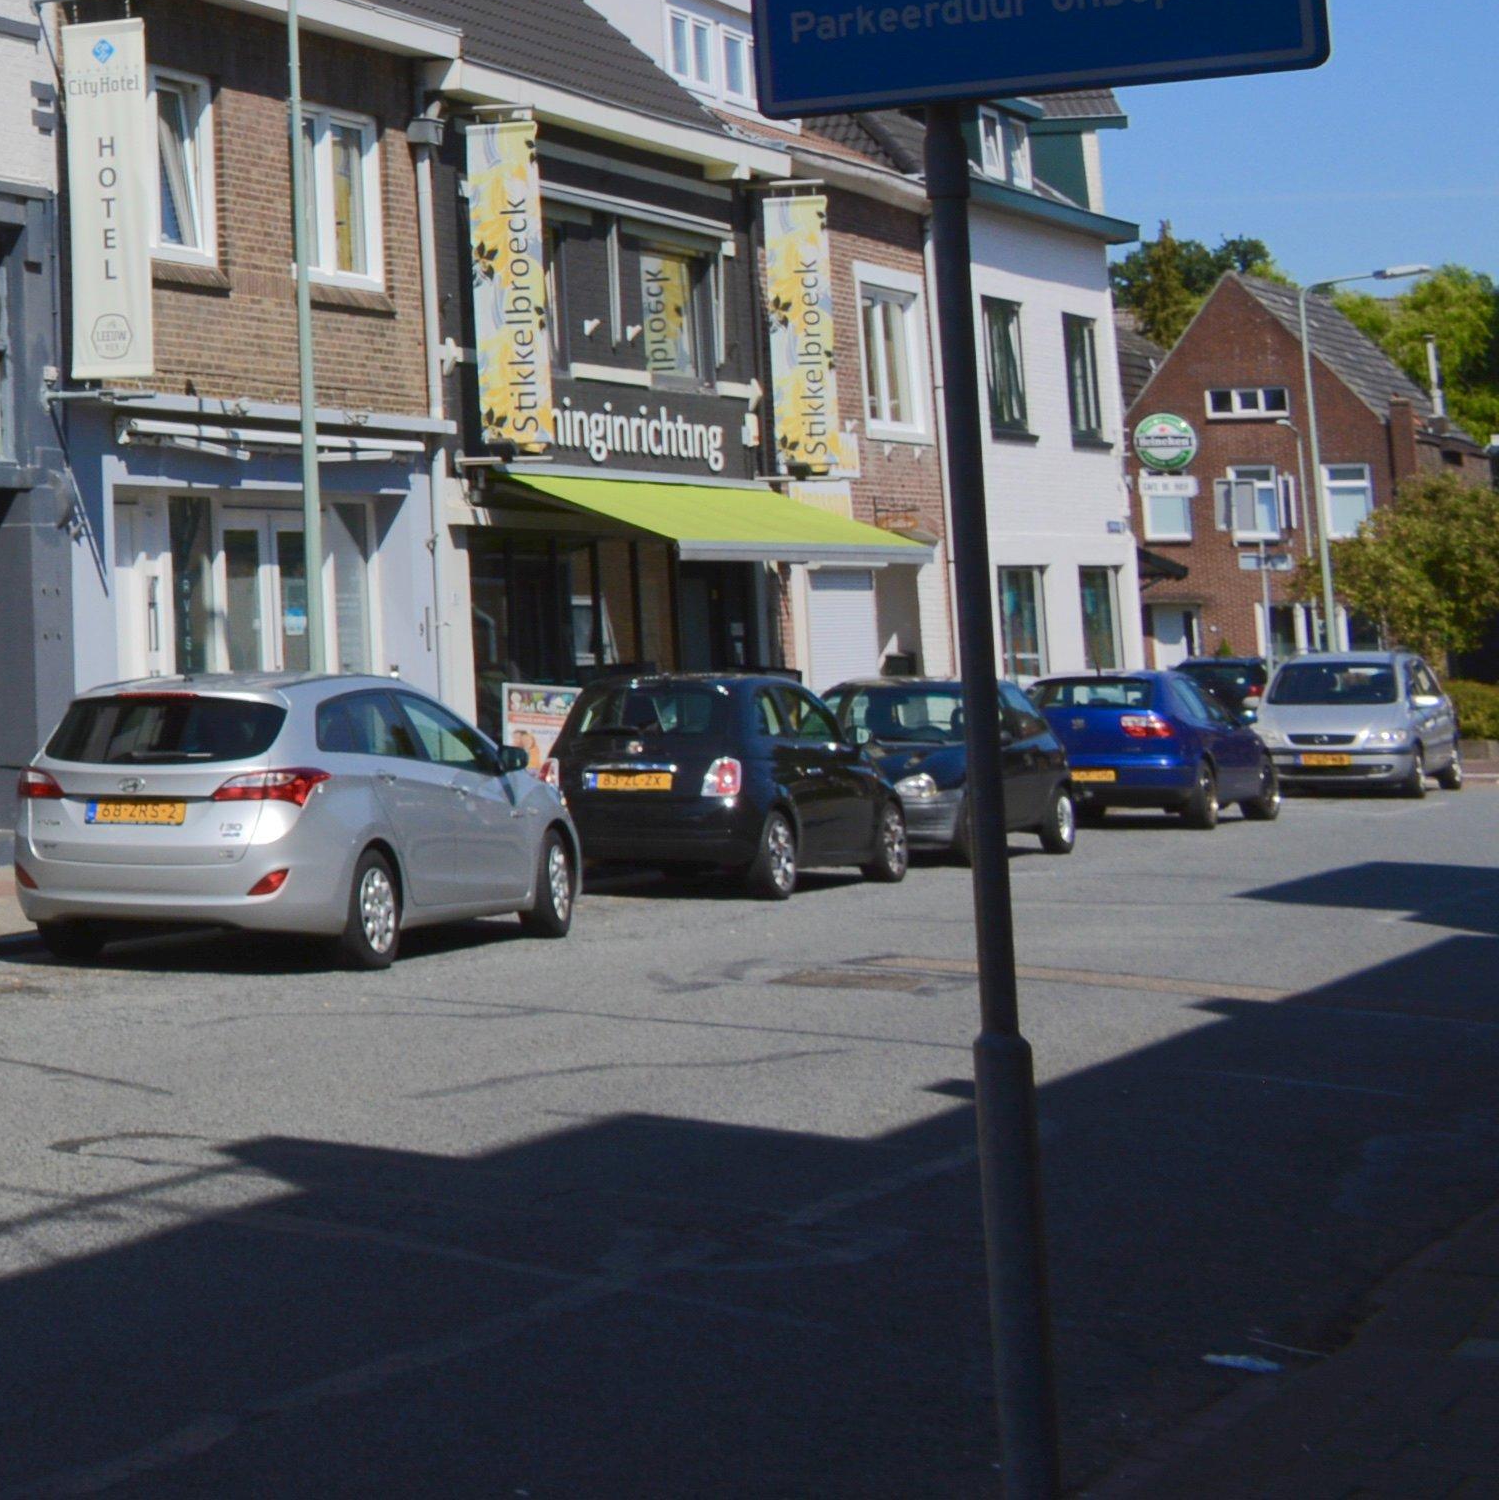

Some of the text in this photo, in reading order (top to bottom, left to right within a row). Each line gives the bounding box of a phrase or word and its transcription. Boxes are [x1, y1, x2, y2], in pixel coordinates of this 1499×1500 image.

[68, 74, 140, 98] CityHotel
[97, 136, 117, 280] HOTEL
[500, 197, 539, 435] Stikkelbroeck
[794, 258, 828, 456] Stikkelbroeck
